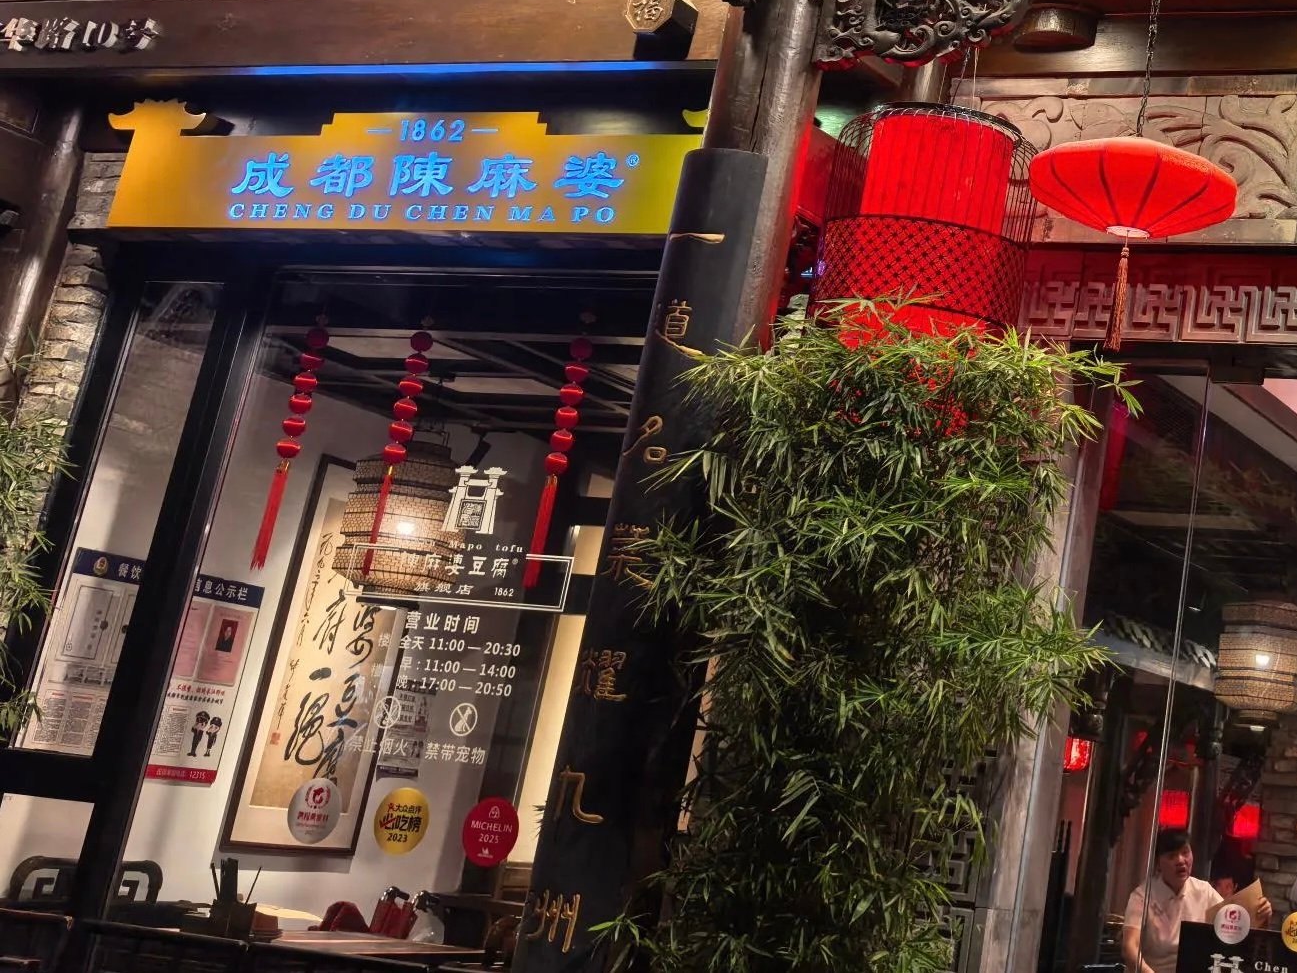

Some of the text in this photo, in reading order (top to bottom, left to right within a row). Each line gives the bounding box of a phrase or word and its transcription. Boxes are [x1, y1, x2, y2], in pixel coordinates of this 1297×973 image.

[400, 119, 465, 142] 1862
[230, 150, 626, 199] 成都陳麻婆
[229, 203, 617, 224] CHENG DU CHEN MA PO
[496, 543, 523, 553] tofu
[494, 587, 515, 597] 1862
[405, 611, 481, 634] 营业时间
[399, 635, 425, 650] 全天
[428, 637, 465, 652] 11:00
[483, 641, 521, 657] 20:30
[424, 659, 460, 673] 11:00
[479, 664, 516, 678] 14:00
[419, 677, 456, 691] 17:00
[475, 681, 512, 696] 20:50
[425, 741, 487, 765] 禁带宠物
[379, 813, 422, 833] 必吃榜
[470, 820, 513, 834] MICHELIN
[386, 833, 408, 843] 2023
[478, 833, 500, 844] 2025
[1254, 961, 1288, 973] Chen
